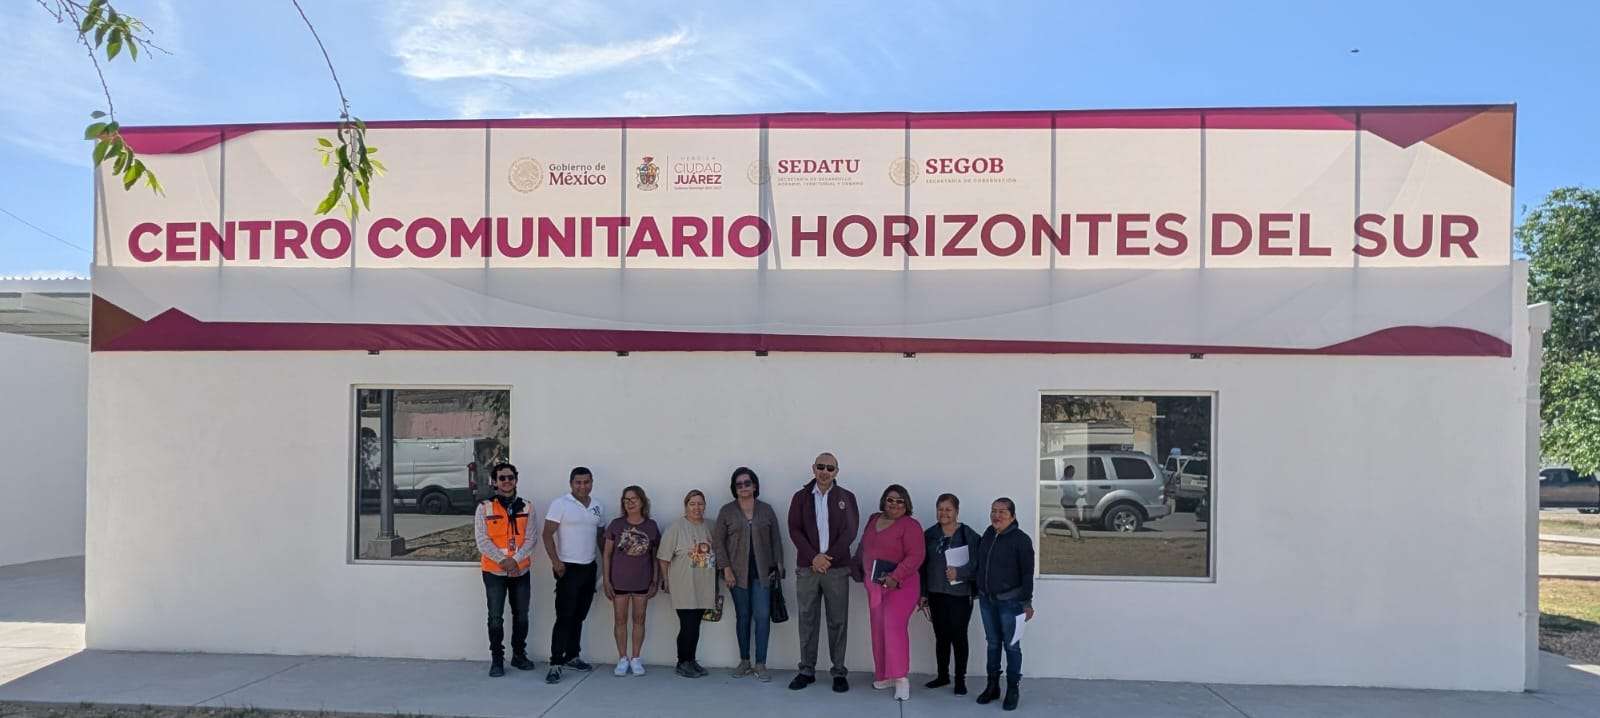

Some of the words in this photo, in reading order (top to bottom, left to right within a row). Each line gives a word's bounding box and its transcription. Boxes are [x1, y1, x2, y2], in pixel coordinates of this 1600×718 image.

[548, 163, 592, 171] Gobierno
[594, 162, 606, 171] de
[674, 162, 722, 174] CIUDAD
[778, 159, 860, 173] SEDATU
[925, 158, 1004, 174] SEGOB
[549, 171, 607, 185] México
[674, 172, 722, 184] JUÁREZ
[128, 218, 352, 262] CENTRO
[368, 215, 771, 259] COMUNITARIO
[791, 213, 1188, 257] HORIZONTES
[1212, 213, 1331, 256] DEL
[1353, 213, 1478, 257] SUR
